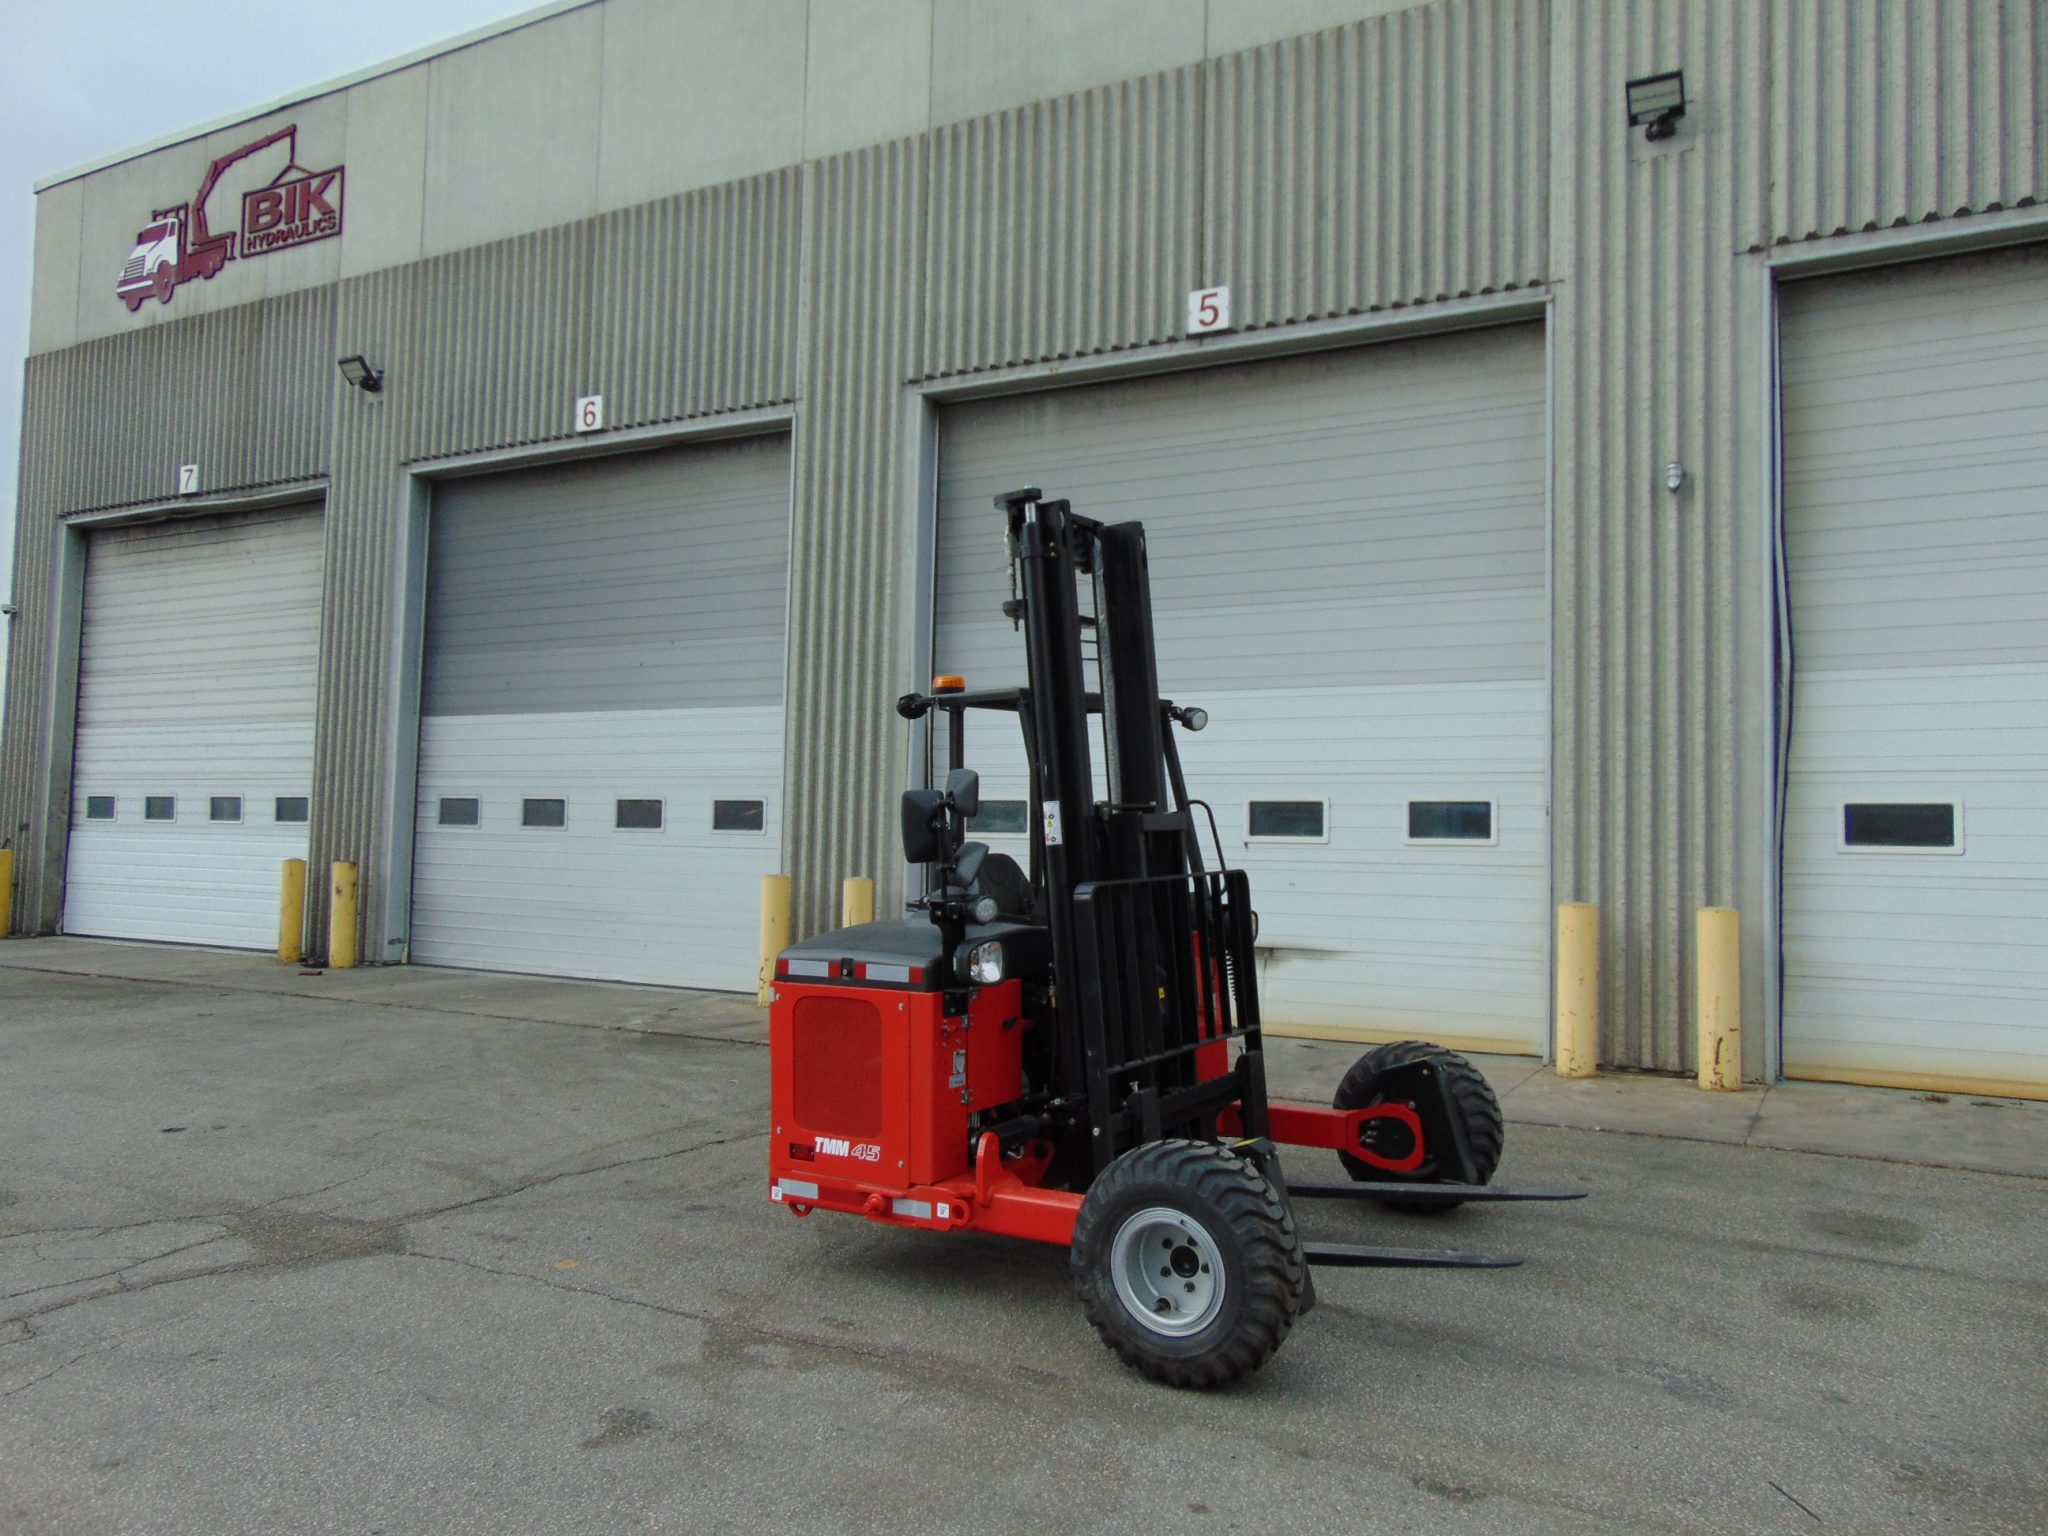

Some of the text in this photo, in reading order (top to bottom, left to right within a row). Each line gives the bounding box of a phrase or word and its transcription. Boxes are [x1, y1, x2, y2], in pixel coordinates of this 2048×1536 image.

[248, 175, 335, 234] BIK
[247, 215, 336, 251] HYDRAULICS
[1199, 292, 1220, 327] 5
[583, 401, 597, 427] 6
[184, 468, 195, 490] 7
[814, 1136, 881, 1162] TMM 45
